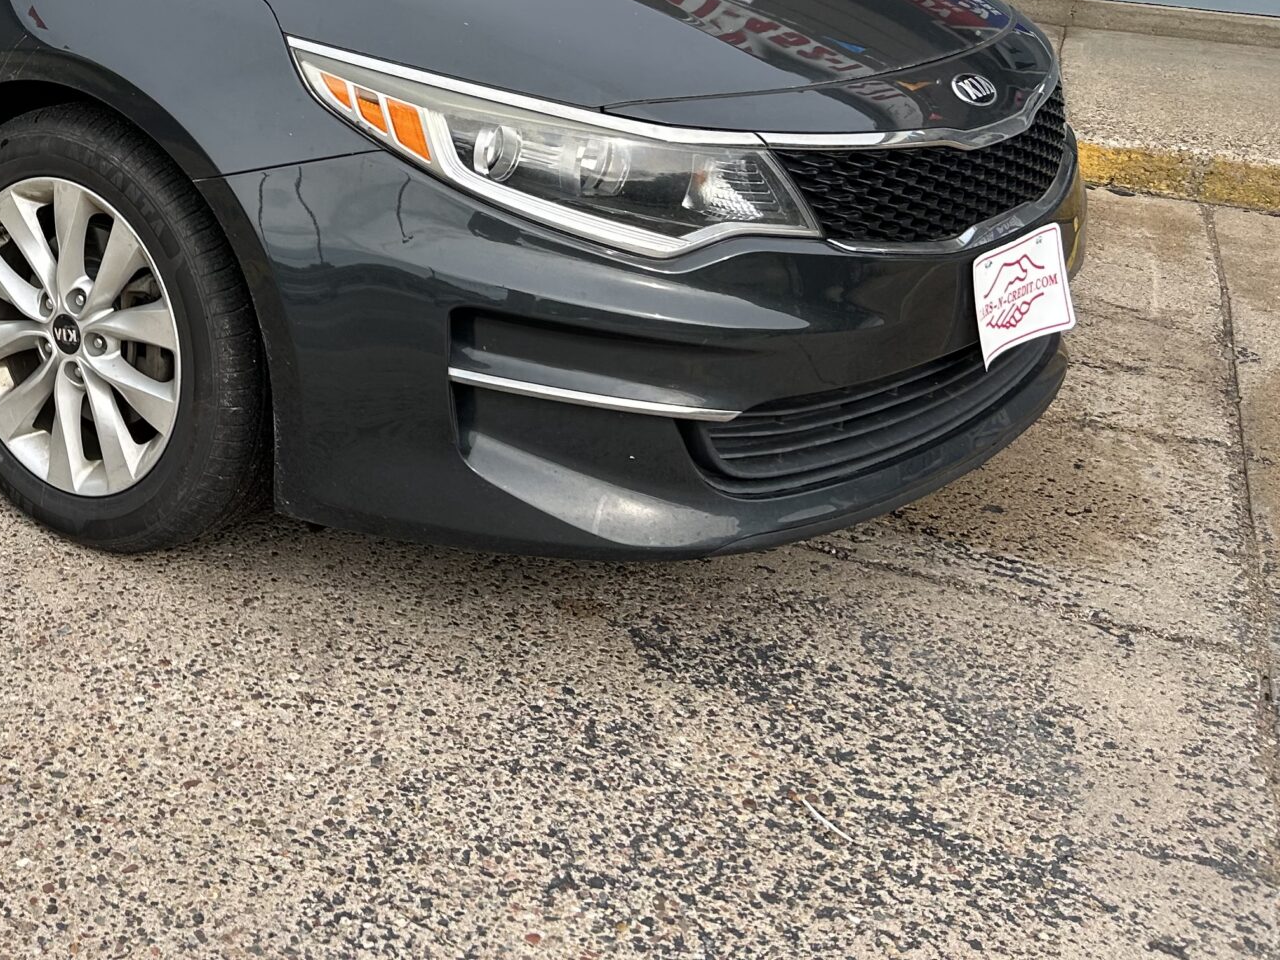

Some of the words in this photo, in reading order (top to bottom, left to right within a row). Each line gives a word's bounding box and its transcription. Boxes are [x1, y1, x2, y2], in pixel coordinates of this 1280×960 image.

[957, 76, 995, 100] KIA
[980, 273, 1058, 320] ARS-N-CREDIT.COM
[53, 327, 77, 342] KIA
